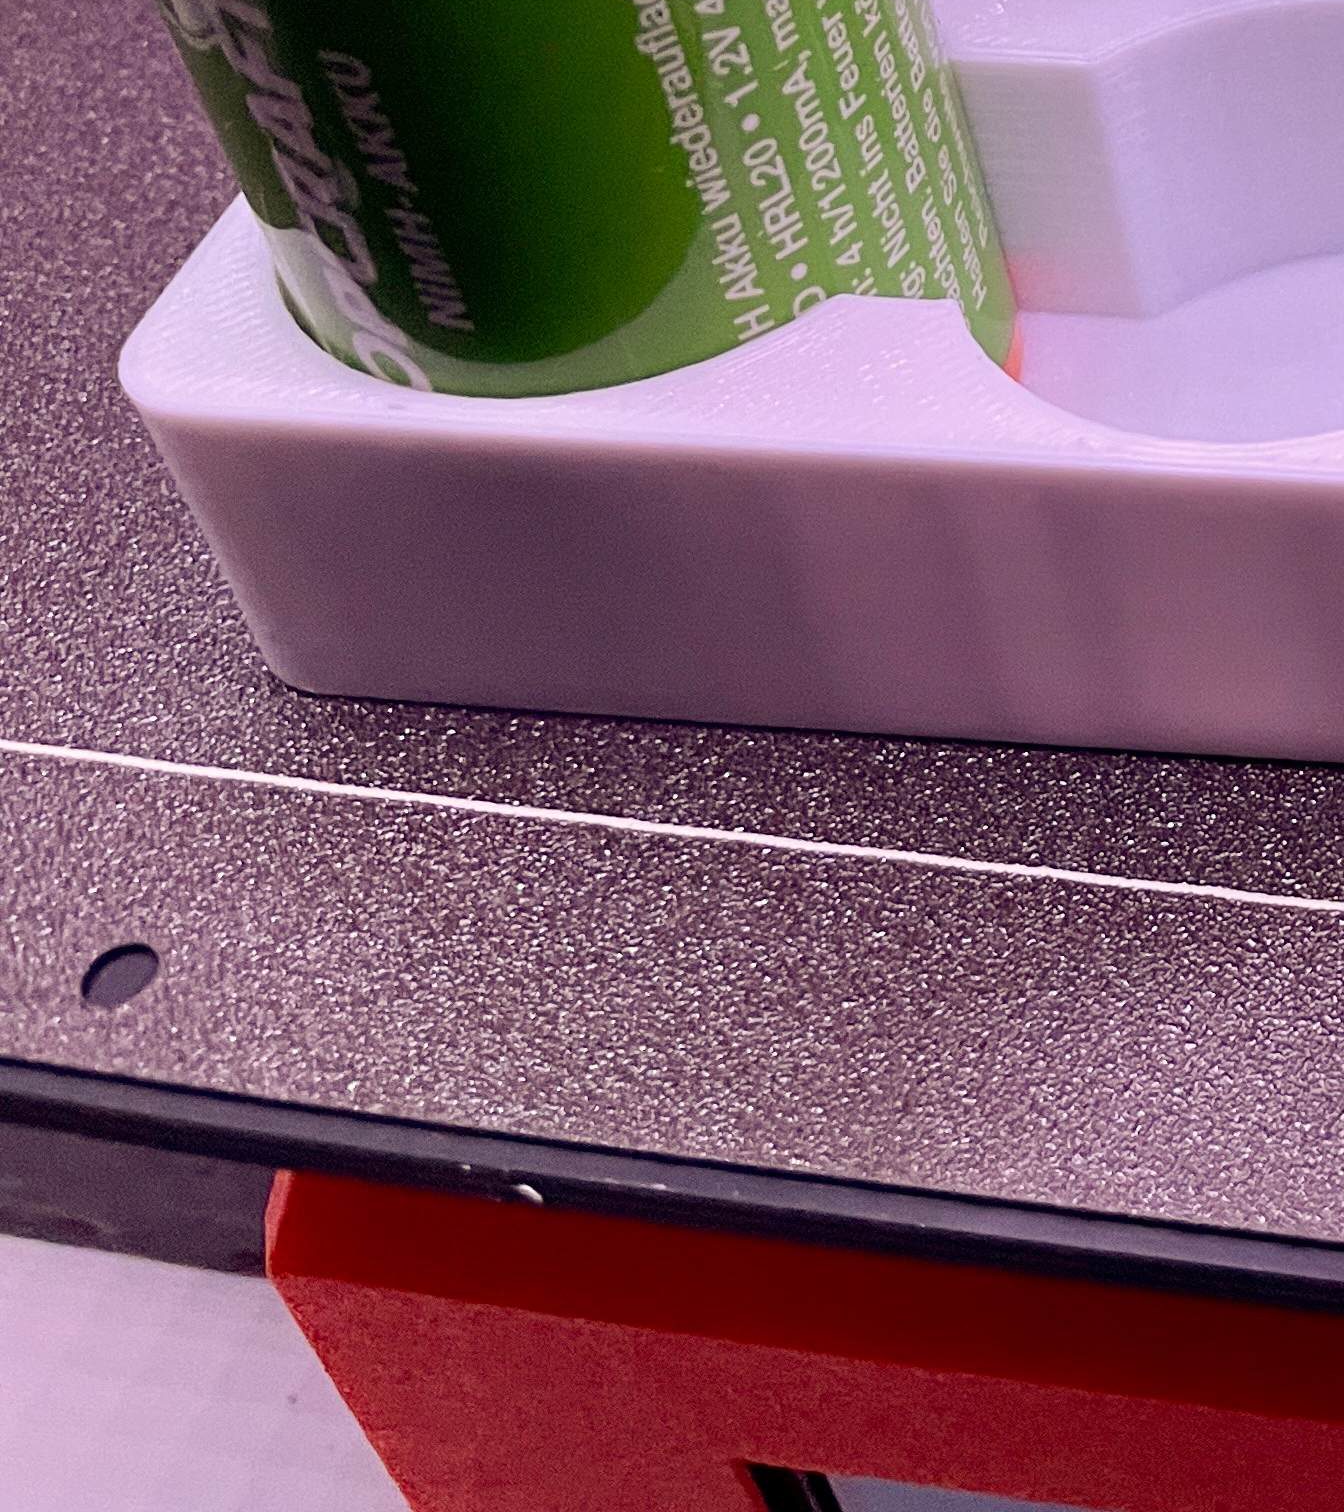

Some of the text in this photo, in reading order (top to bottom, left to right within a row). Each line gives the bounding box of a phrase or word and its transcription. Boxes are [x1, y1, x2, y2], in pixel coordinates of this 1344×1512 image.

[702, 26, 759, 109] 1.2V
[822, 11, 867, 121] Feuer
[855, 114, 885, 177] ins
[872, 31, 928, 195] Batterien
[921, 87, 943, 144] die
[742, 137, 809, 261] HRL20
[938, 144, 959, 206] Sie
[711, 212, 765, 301] Akku
[836, 241, 864, 267] 4
[868, 169, 911, 269] Nicht
